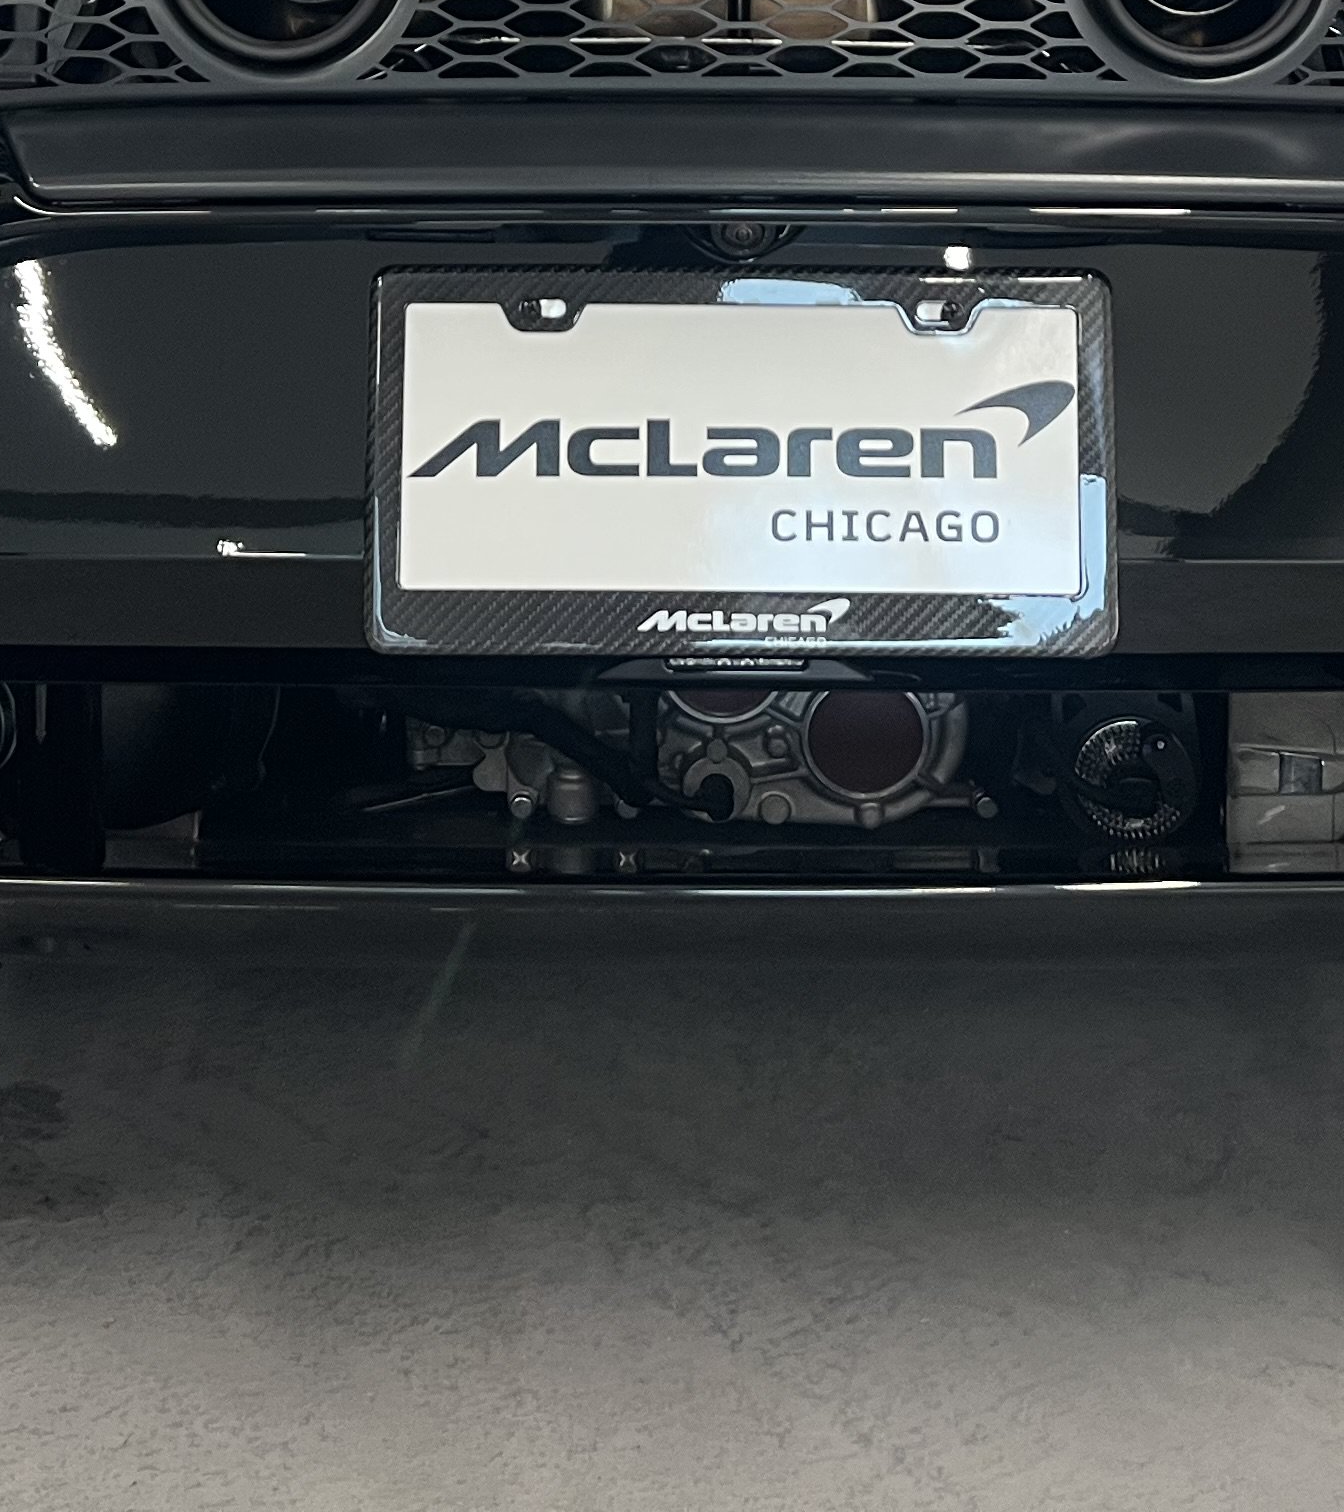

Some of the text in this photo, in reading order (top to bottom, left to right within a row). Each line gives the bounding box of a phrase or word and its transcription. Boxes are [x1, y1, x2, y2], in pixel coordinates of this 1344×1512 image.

[407, 418, 998, 479] McLaren
[771, 509, 1000, 543] CHICAGO
[637, 609, 827, 633] McLaren
